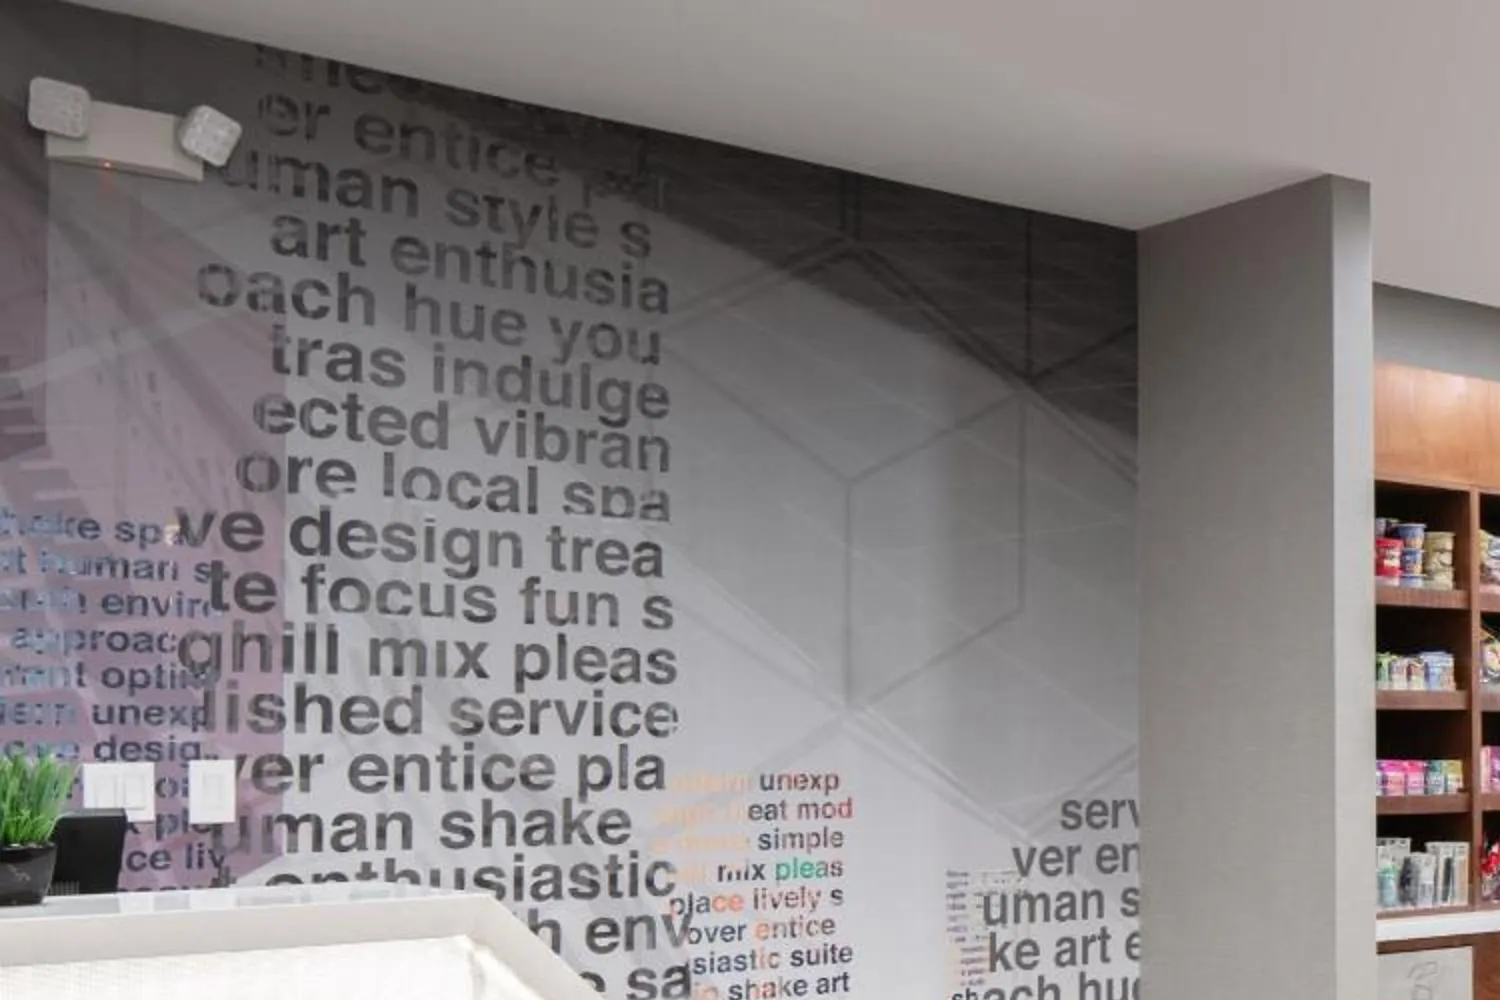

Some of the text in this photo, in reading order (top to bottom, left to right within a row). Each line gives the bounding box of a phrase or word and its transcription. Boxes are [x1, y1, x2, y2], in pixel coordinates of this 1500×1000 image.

[354, 112, 560, 187] entice
[444, 186, 599, 250] style
[620, 219, 652, 258] s
[271, 213, 669, 315] art enthusia
[197, 263, 660, 365] oach hue you
[272, 323, 670, 427] tras indulge
[253, 392, 670, 472] ected vibran
[235, 451, 671, 523] ore local spa
[174, 505, 663, 578] ve design trea
[210, 559, 673, 630] te focus fun s
[178, 618, 678, 690] ghill mix pleas
[204, 680, 678, 740] lished service
[348, 742, 556, 792] entice
[578, 745, 665, 800] pla
[759, 771, 840, 796] unexp
[439, 799, 631, 850] shake
[748, 800, 787, 821] eat
[798, 796, 854, 819] mod
[758, 826, 844, 854] simple
[1012, 844, 1082, 878] ver
[775, 858, 844, 886] pleas
[668, 886, 844, 918] place lively s
[983, 889, 1104, 926] uman
[585, 905, 693, 954] env
[687, 915, 835, 945] over entice
[790, 942, 853, 967] suite
[989, 932, 1040, 972] ke
[1055, 927, 1111, 968] art
[815, 972, 850, 995] art
